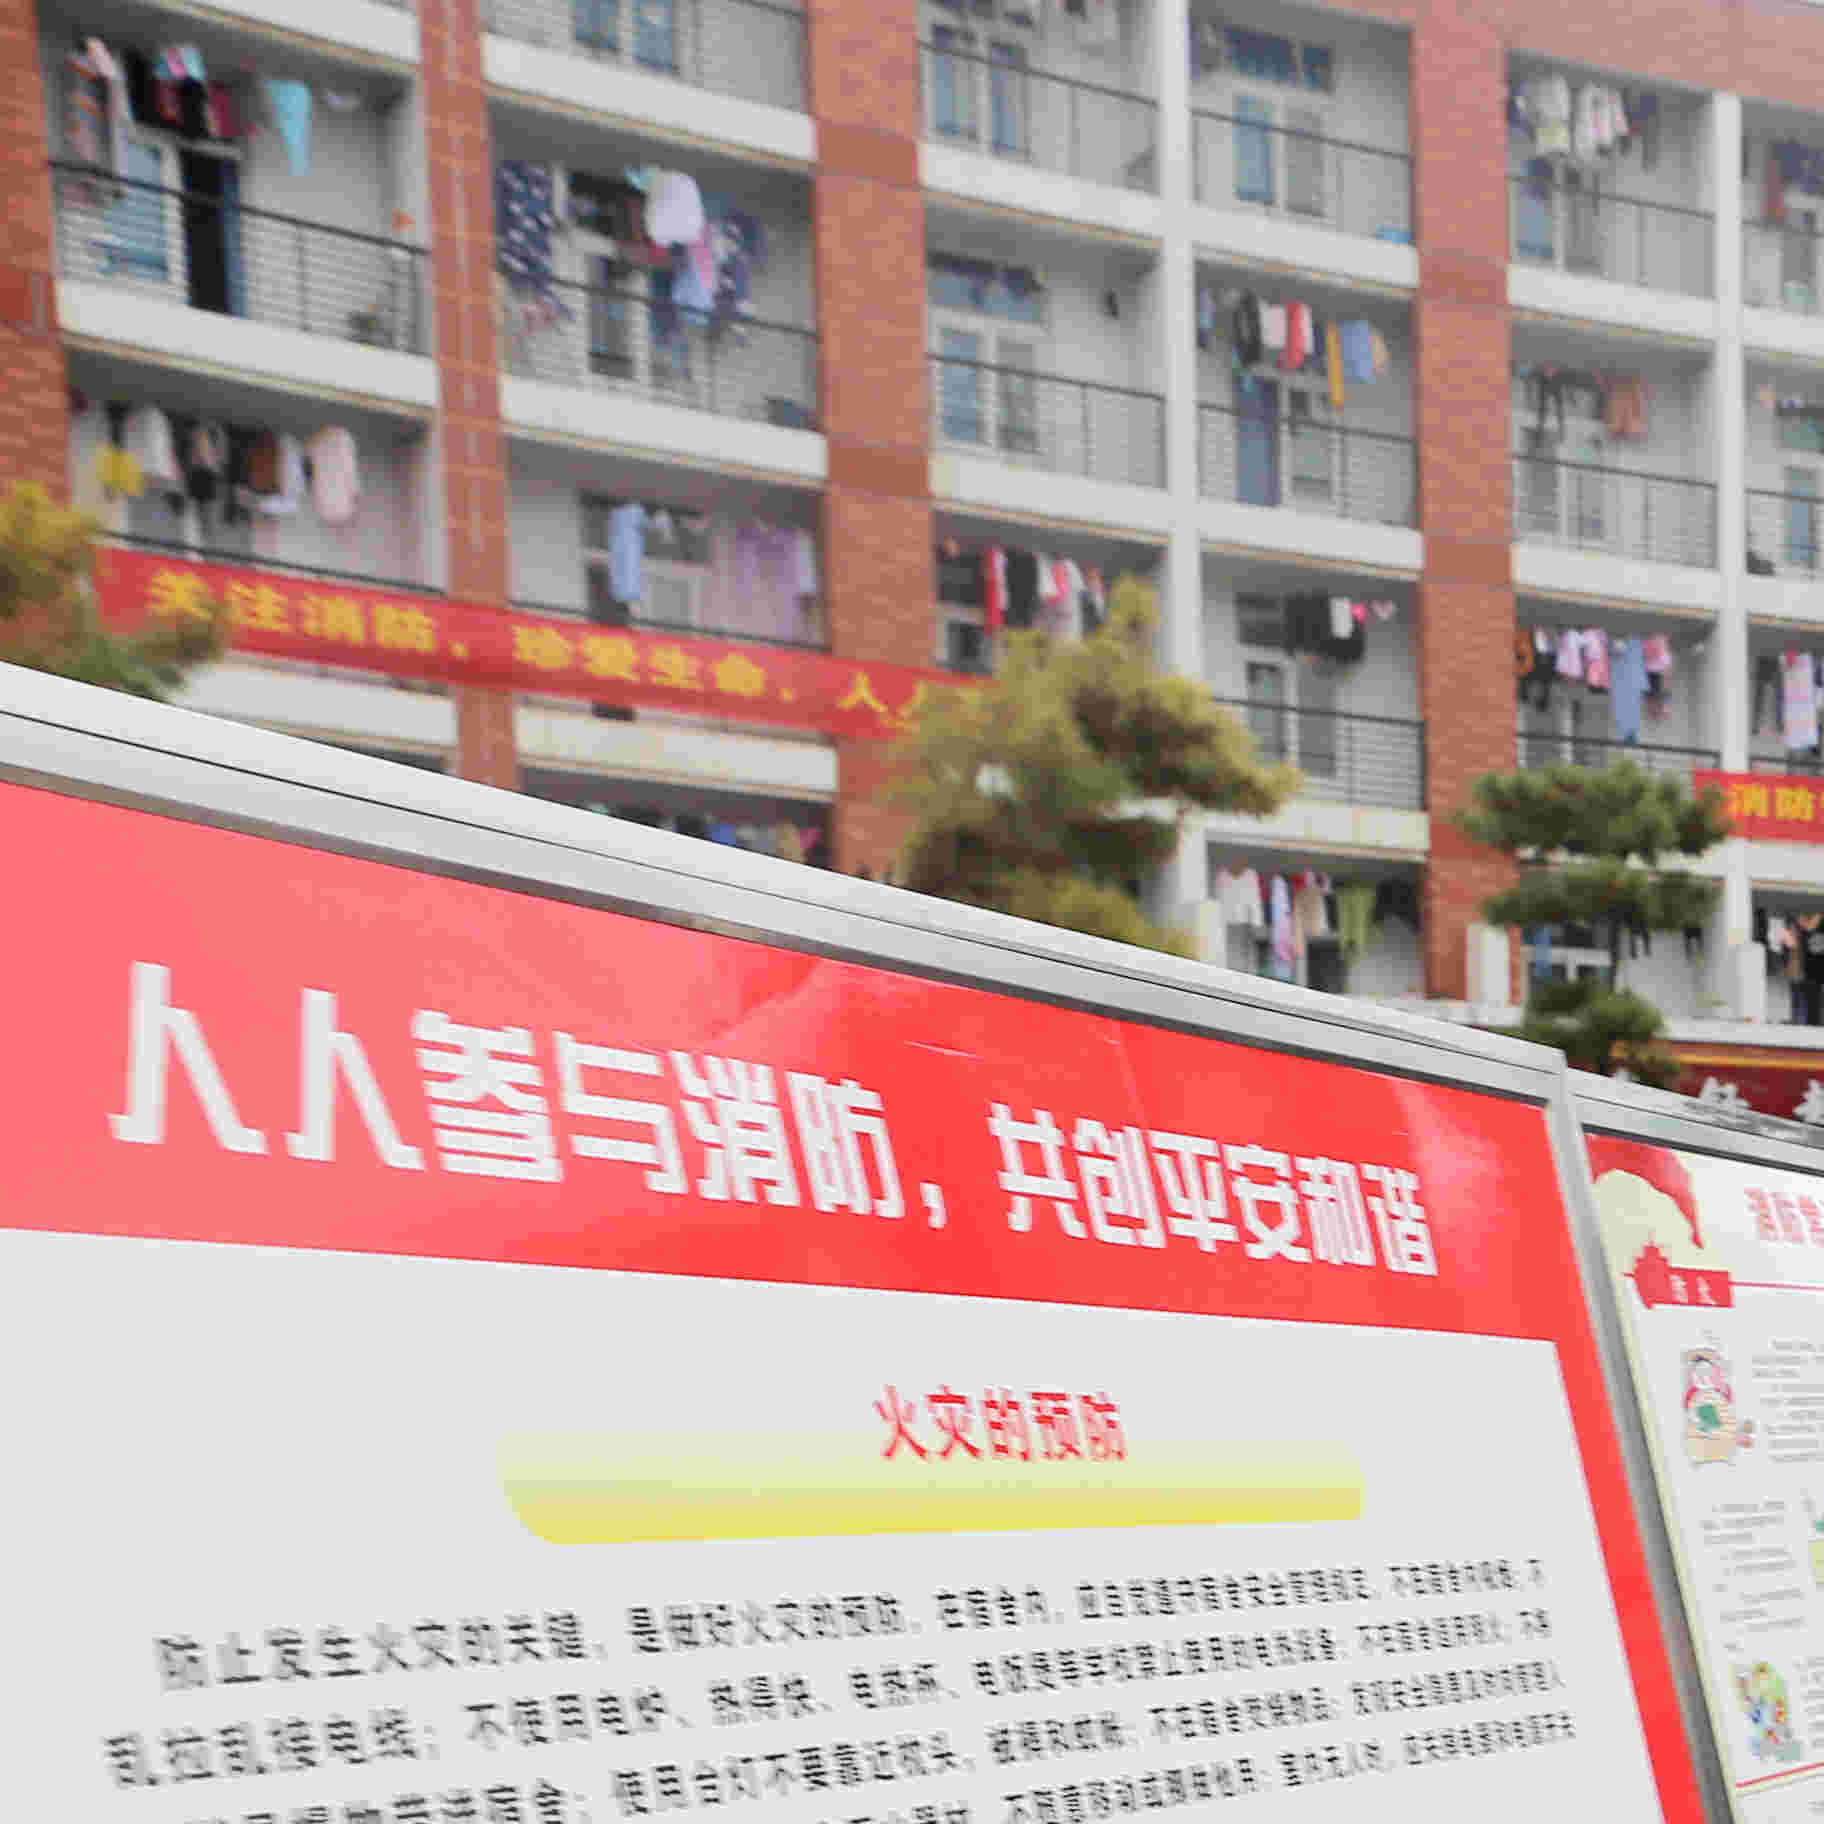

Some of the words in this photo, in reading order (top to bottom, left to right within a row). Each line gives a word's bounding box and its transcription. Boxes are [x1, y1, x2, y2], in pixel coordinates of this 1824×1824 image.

[873, 1384, 1128, 1462] 火灾的预防
